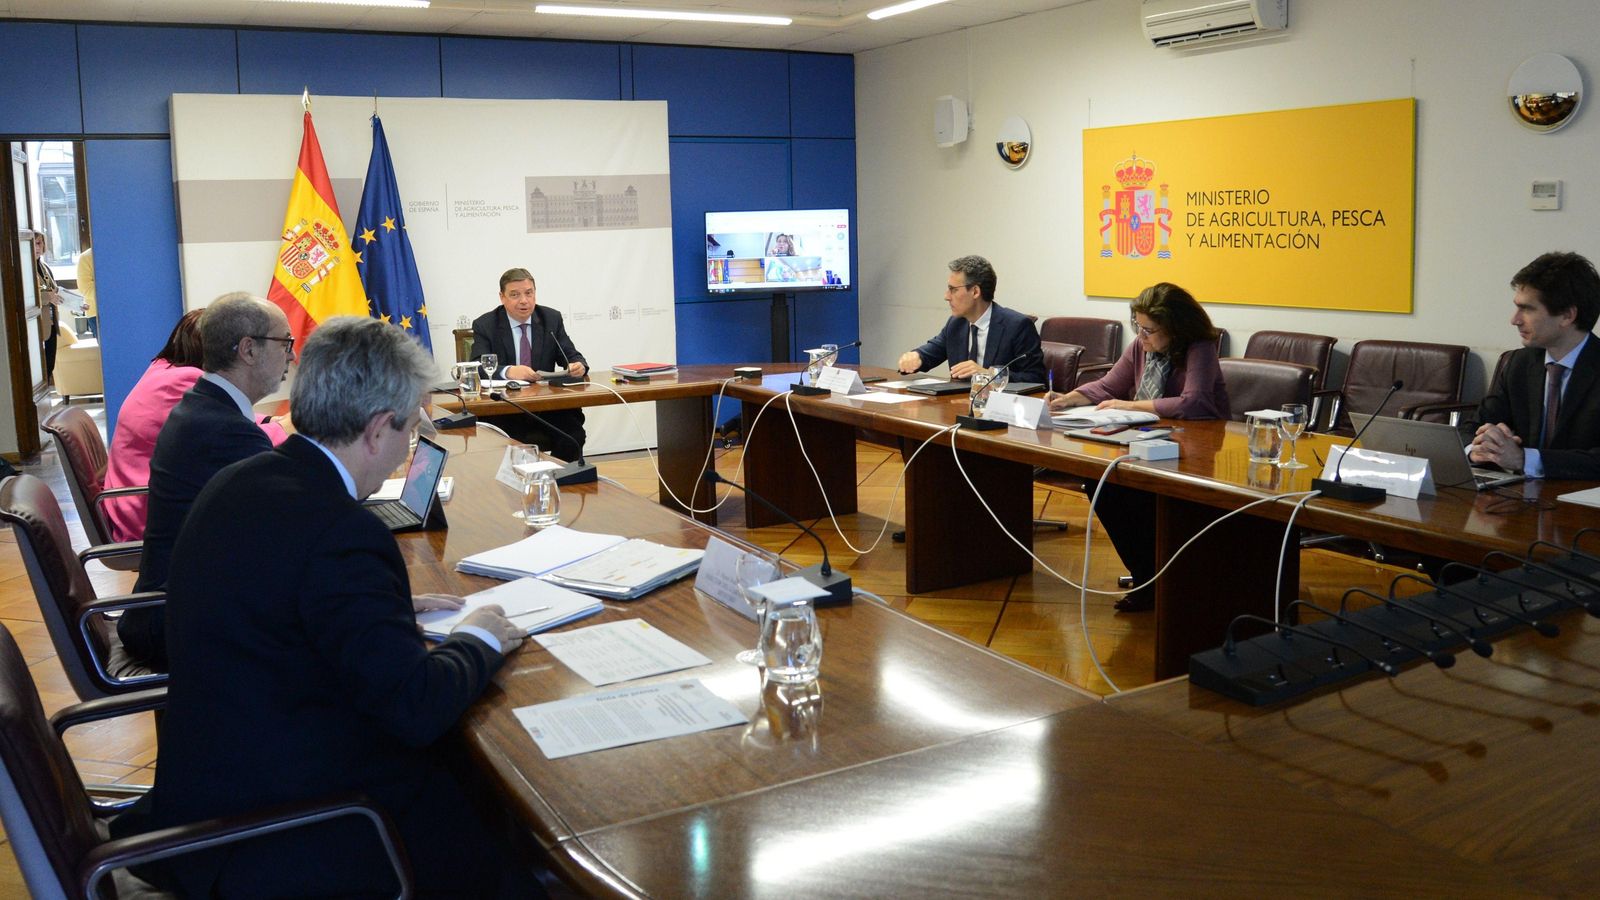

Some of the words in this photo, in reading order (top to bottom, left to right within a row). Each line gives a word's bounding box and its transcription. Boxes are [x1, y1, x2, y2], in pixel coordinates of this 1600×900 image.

[1186, 189, 1270, 206] MINISTERIO
[1186, 212, 1205, 227] DE
[1209, 210, 1326, 229] AGRICULTURA,
[1332, 209, 1386, 227] PESCA
[1186, 232, 1195, 248] Y
[1199, 229, 1320, 249] ALIMENTACIÓN
